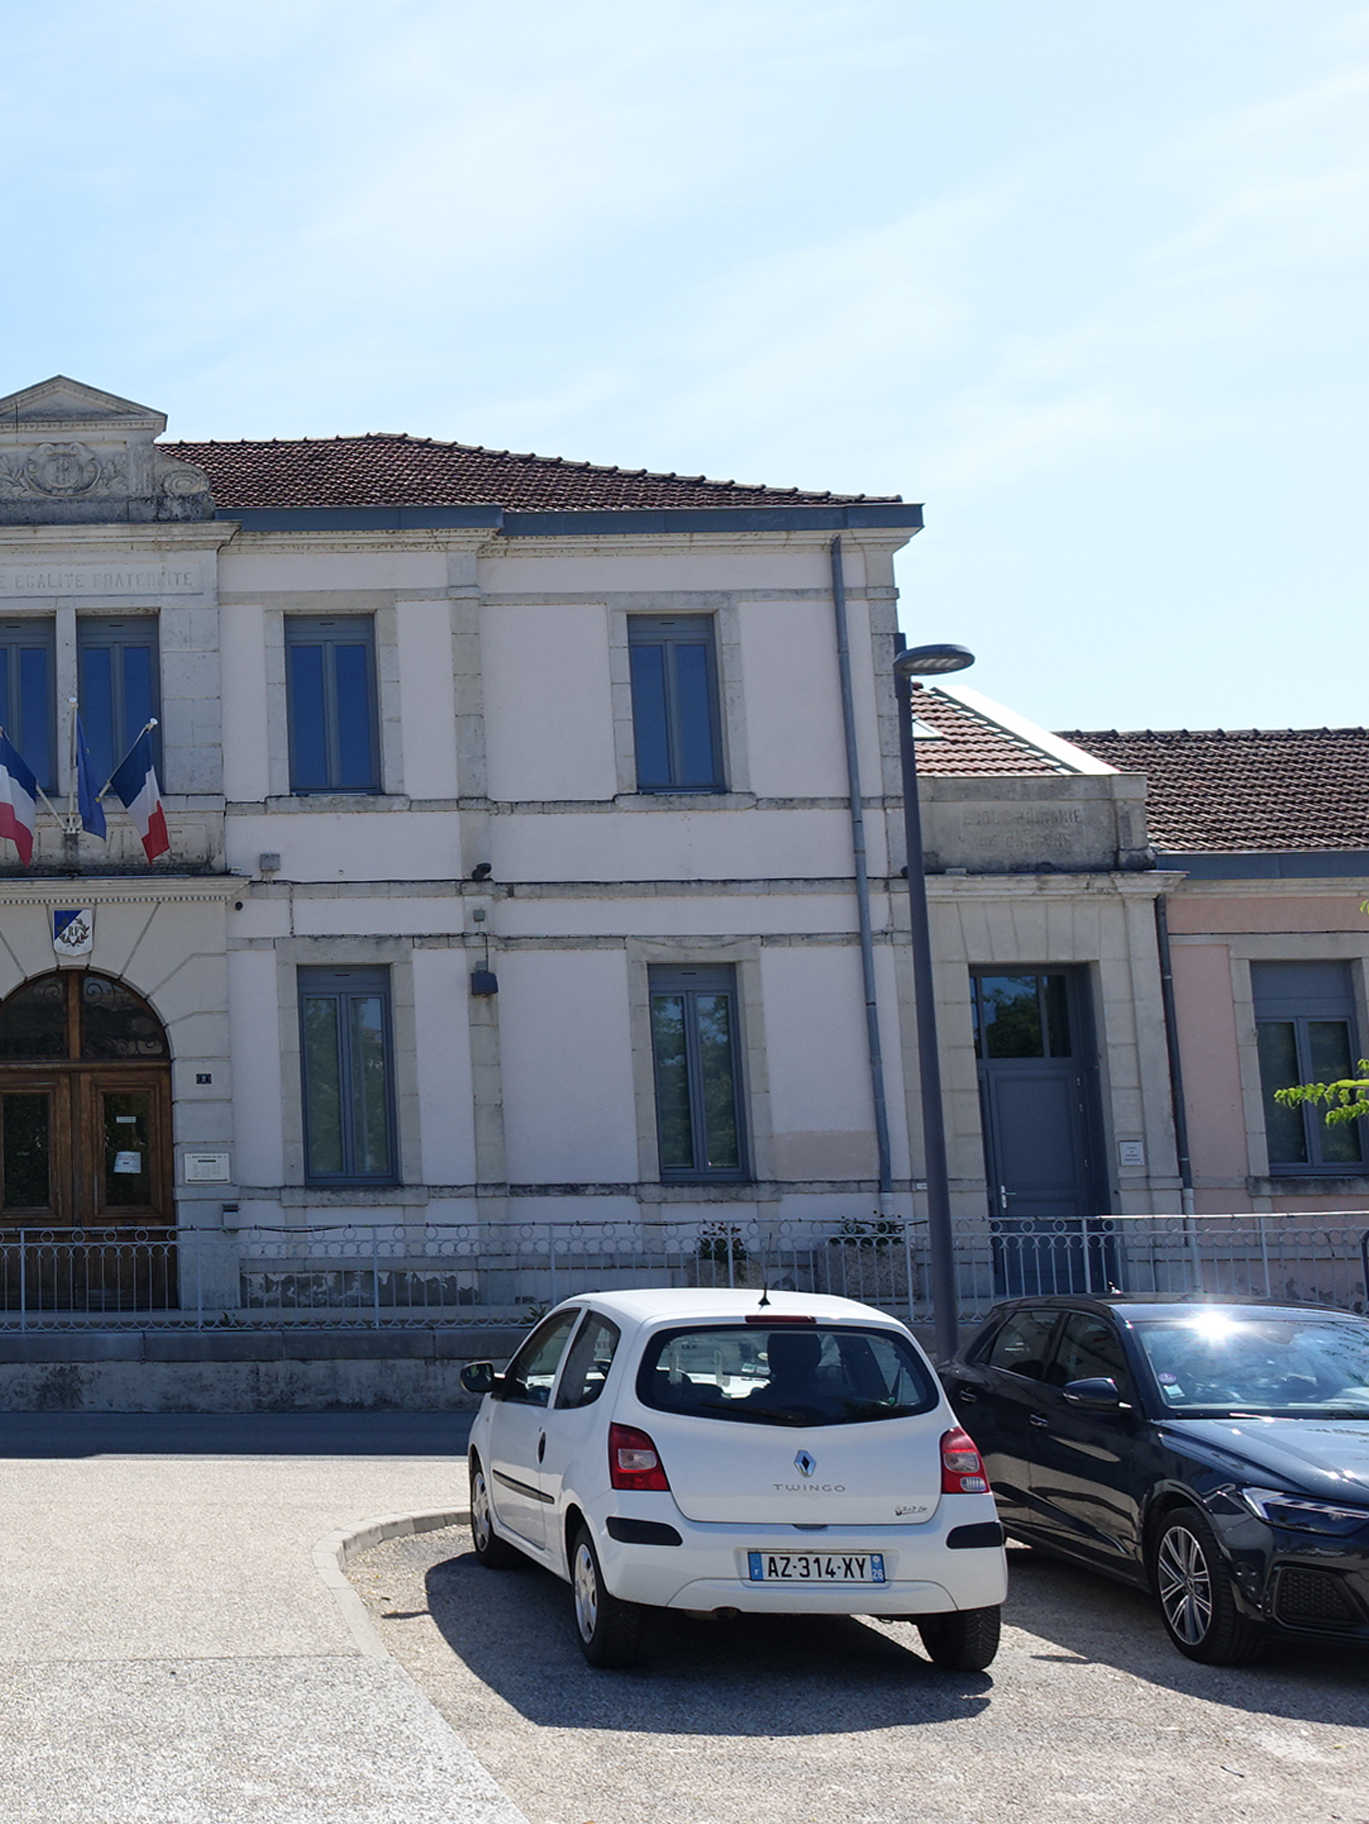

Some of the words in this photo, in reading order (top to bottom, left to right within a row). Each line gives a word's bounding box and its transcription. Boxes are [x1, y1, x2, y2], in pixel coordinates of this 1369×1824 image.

[772, 1483, 846, 1493] TWINGO
[767, 1556, 866, 1579] AZ-314-XY
[872, 1568, 884, 1579] 26
